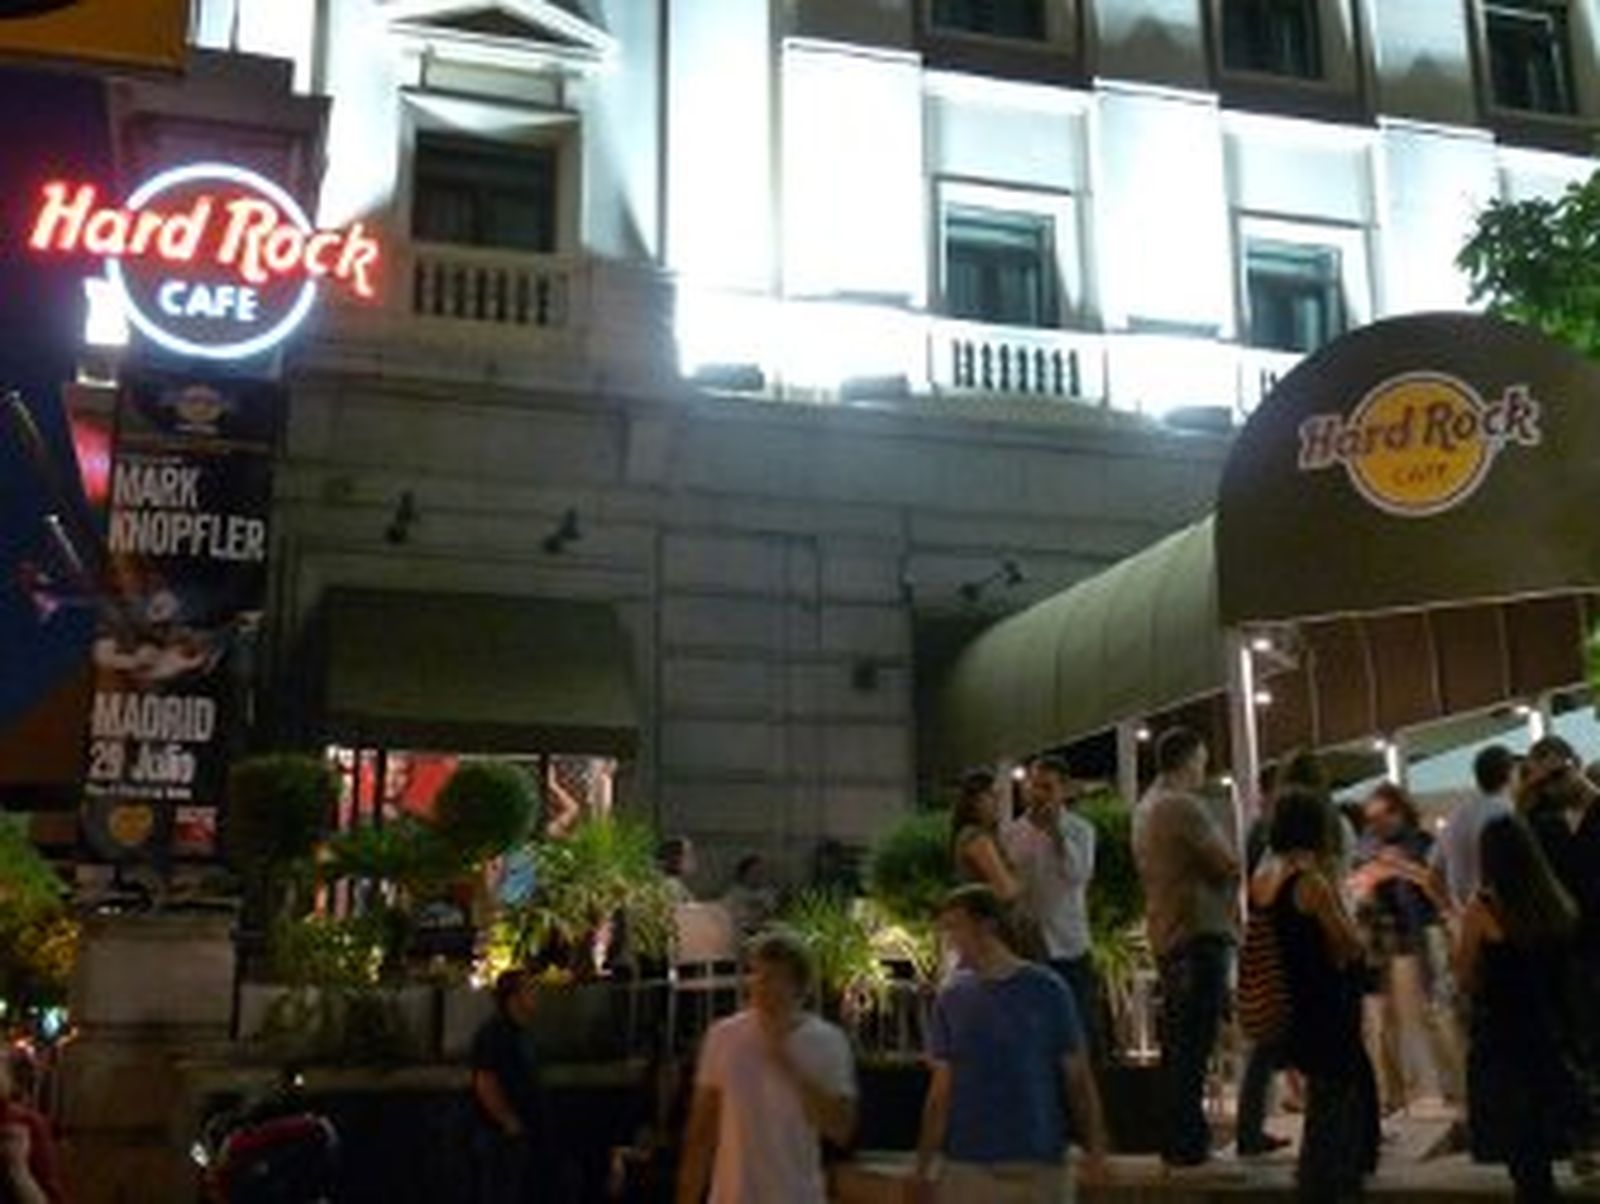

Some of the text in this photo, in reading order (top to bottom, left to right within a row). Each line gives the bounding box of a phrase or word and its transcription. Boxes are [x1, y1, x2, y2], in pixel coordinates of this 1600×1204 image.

[29, 181, 380, 297] Hard Rock
[158, 281, 258, 322] CAFE
[1300, 386, 1540, 464] Hard Rock
[114, 463, 200, 507] MARK
[108, 509, 265, 561] KNOPFLER
[90, 691, 216, 742] MADRID
